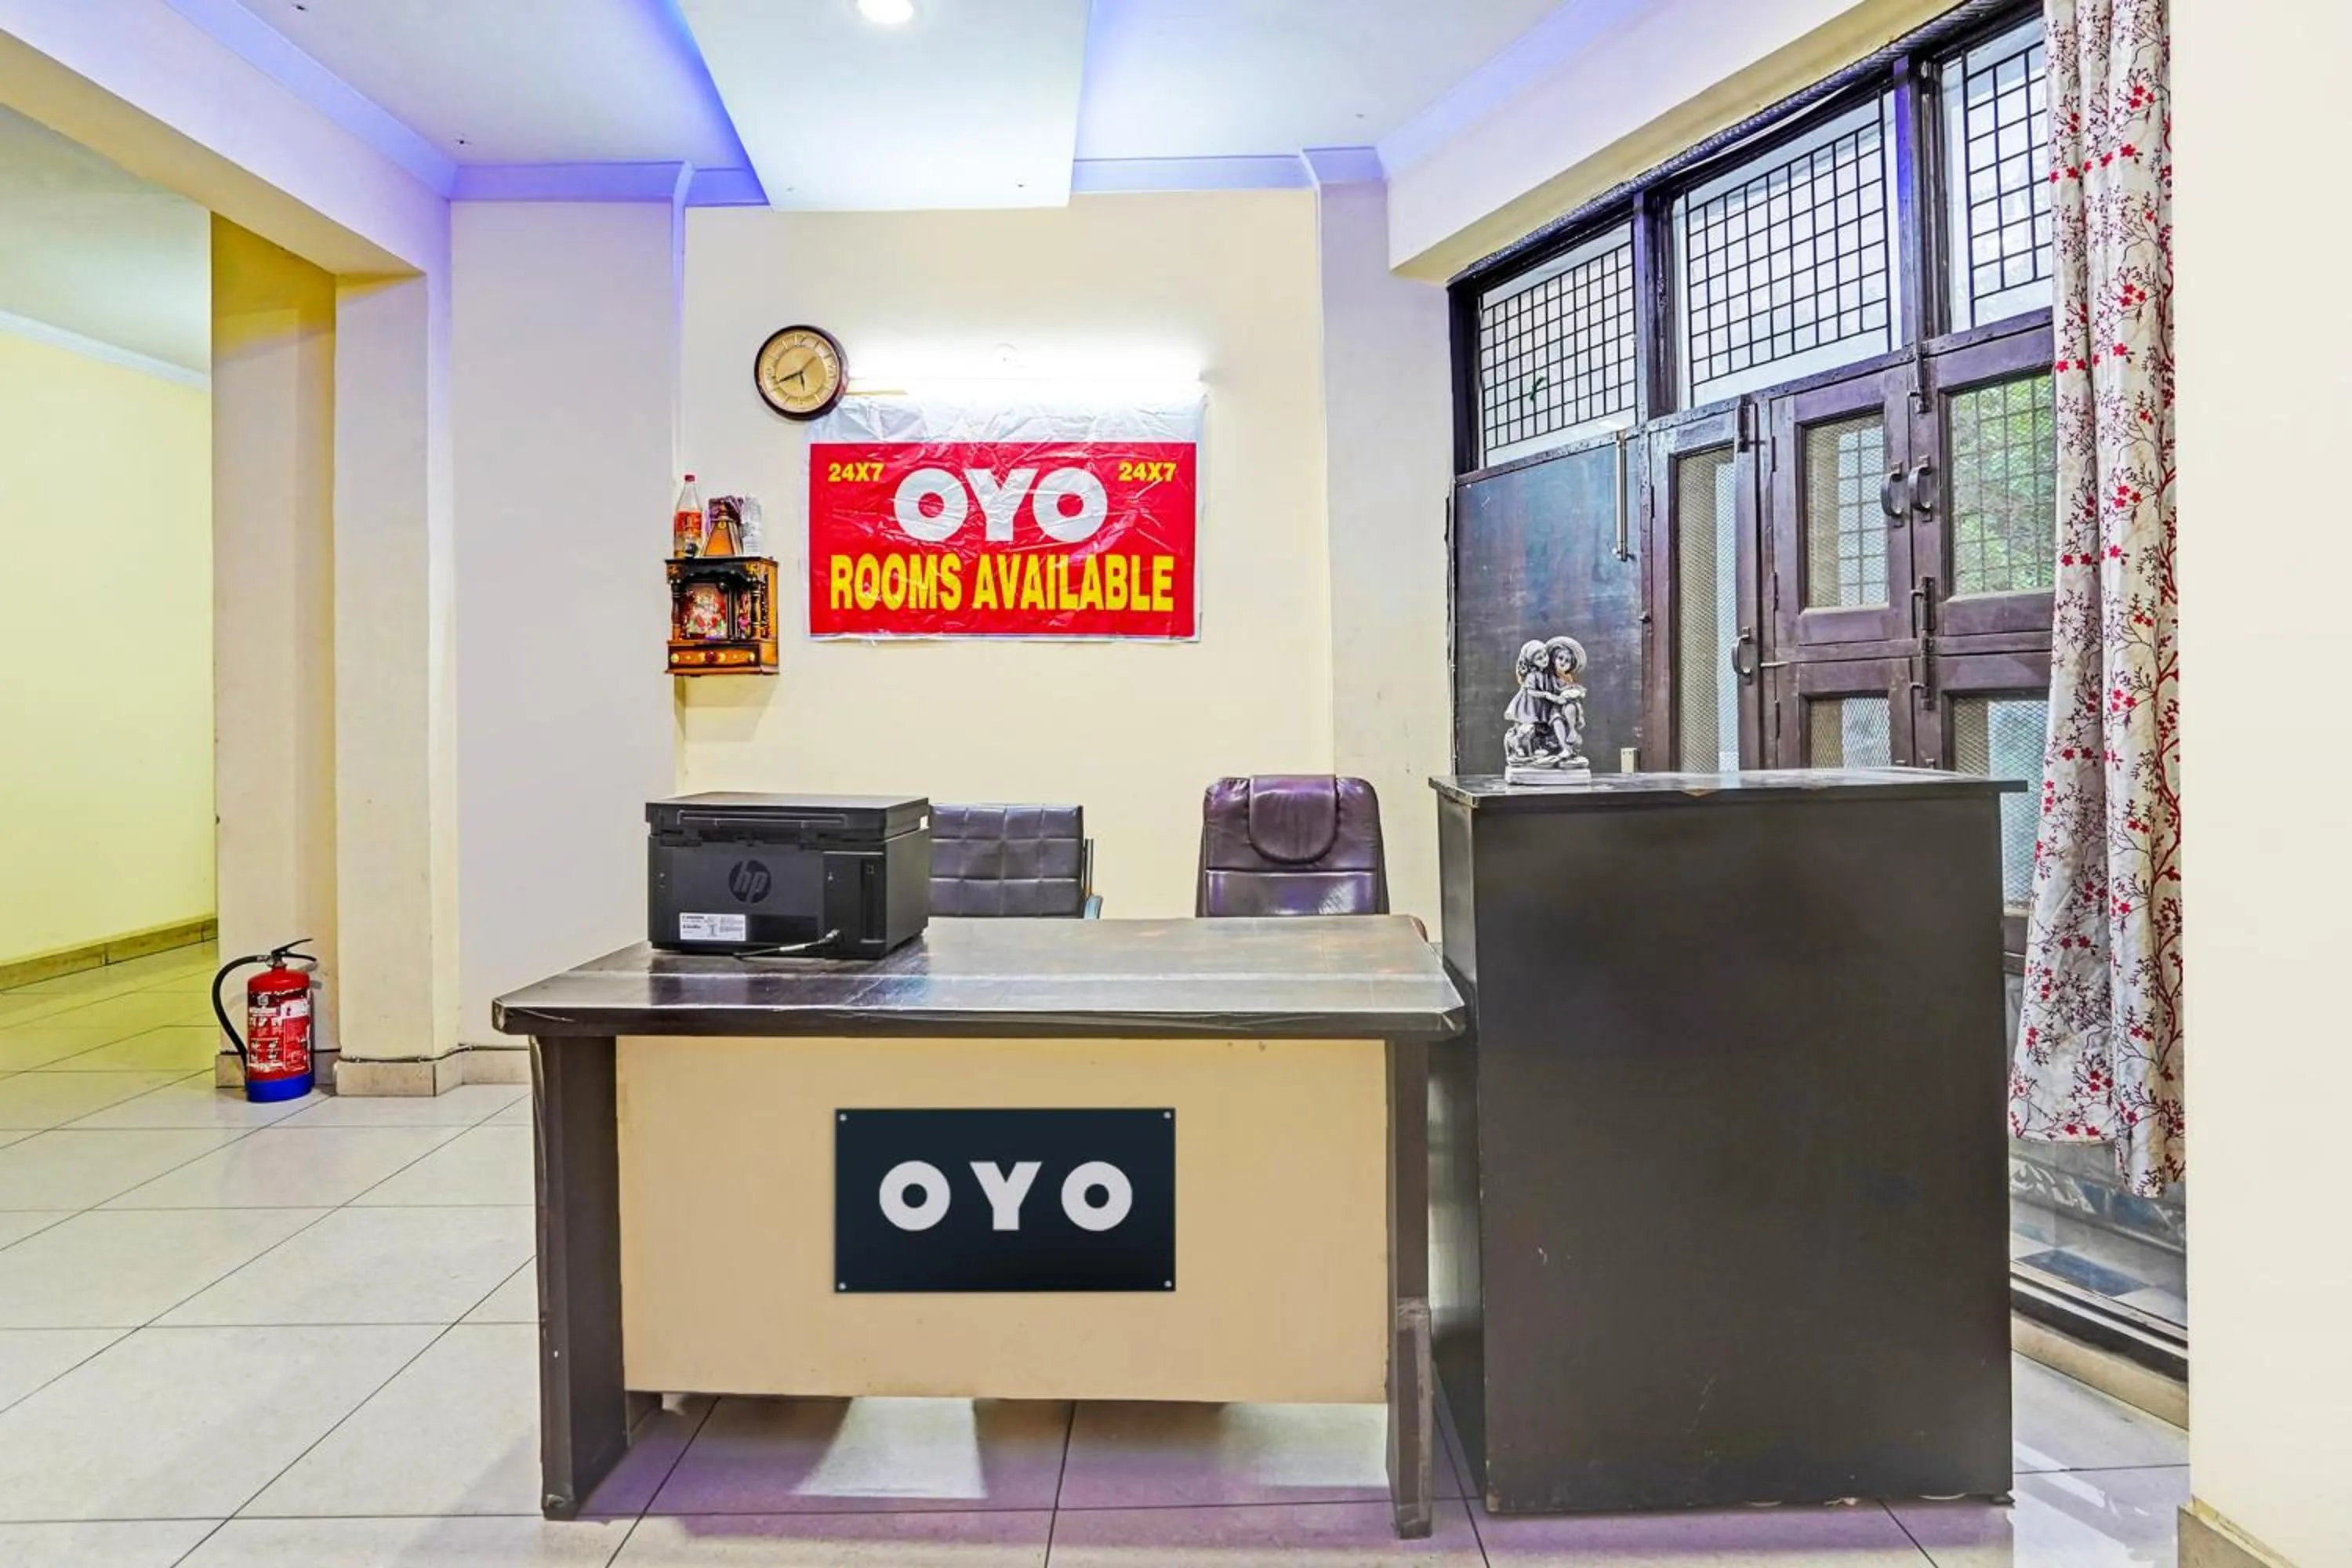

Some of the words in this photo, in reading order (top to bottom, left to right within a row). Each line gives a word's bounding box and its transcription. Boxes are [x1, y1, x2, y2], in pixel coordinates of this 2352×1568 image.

[828, 463, 884, 482] 24X7
[1119, 462, 1177, 482] 24X7
[894, 467, 1109, 543] OYO
[830, 553, 962, 611] ROOMS
[972, 554, 1174, 612] AVAILABLE
[732, 861, 768, 903] hp
[878, 1160, 1134, 1232] OYO
